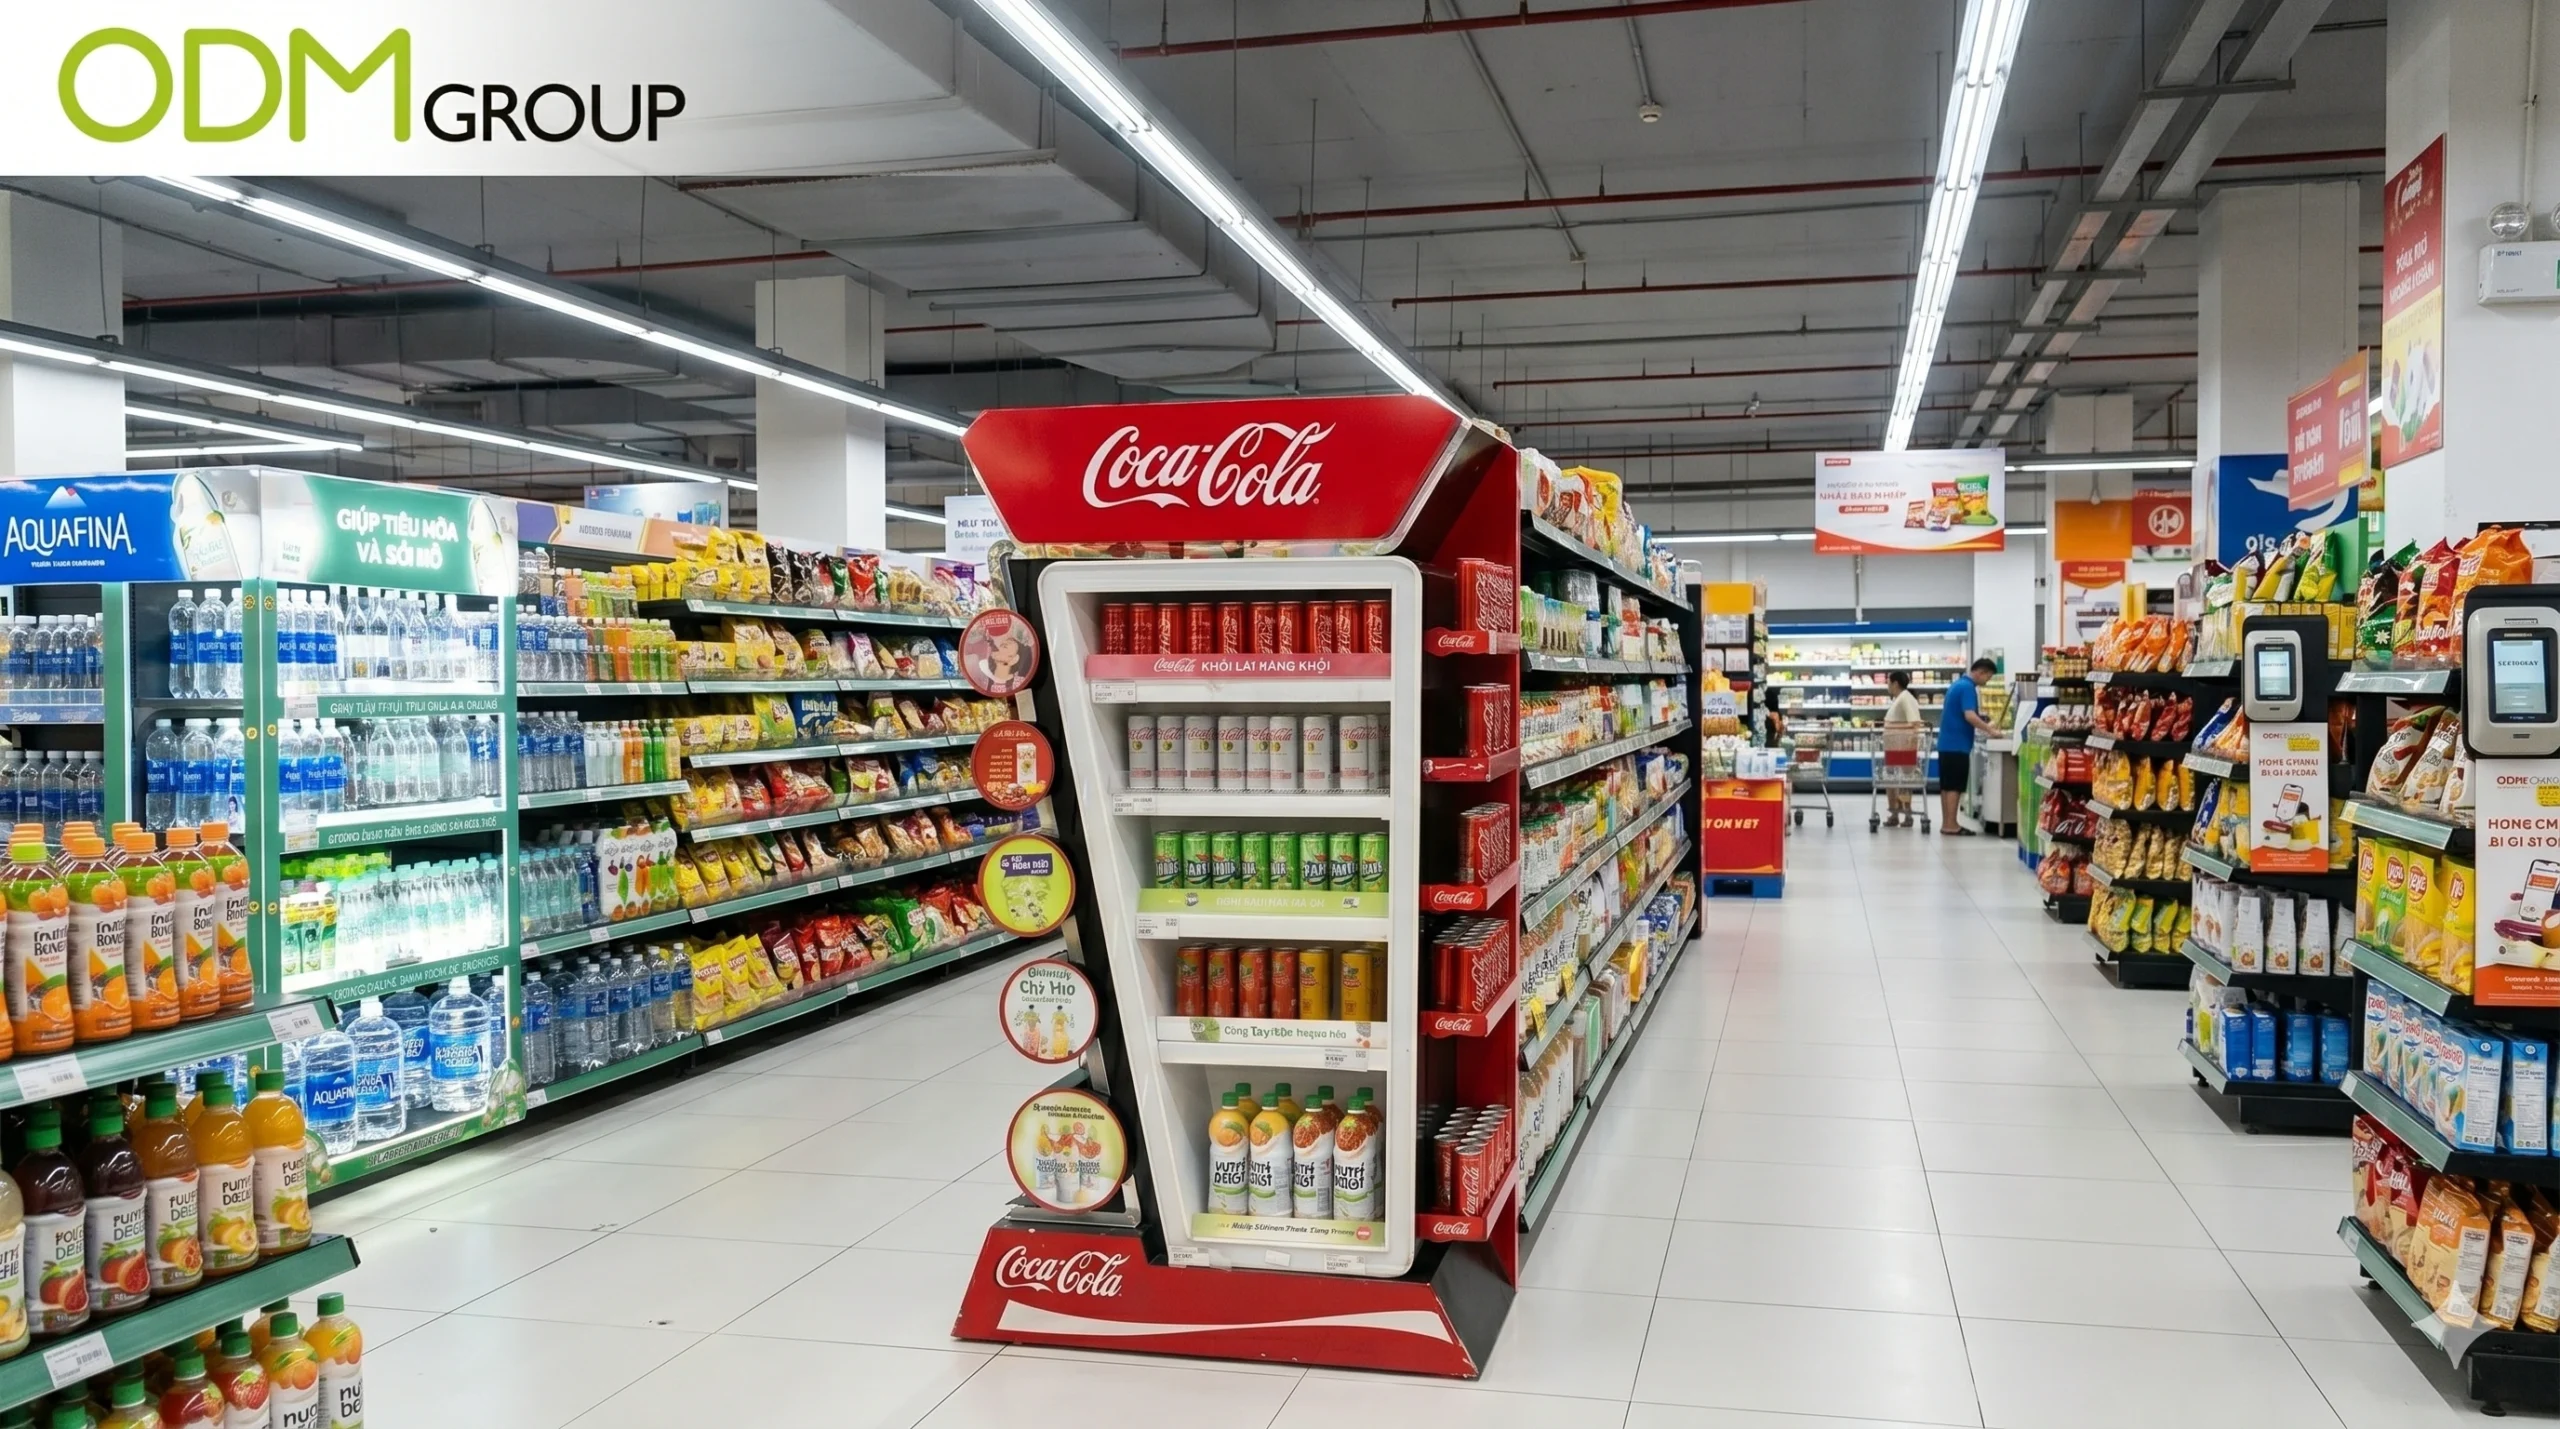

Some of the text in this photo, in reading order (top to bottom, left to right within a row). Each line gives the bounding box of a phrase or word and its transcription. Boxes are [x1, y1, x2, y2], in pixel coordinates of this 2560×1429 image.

[1083, 421, 1336, 508] Coca-Cola
[3, 512, 135, 557] AQUAFINA
[996, 1246, 1131, 1297] Coca-Cola
